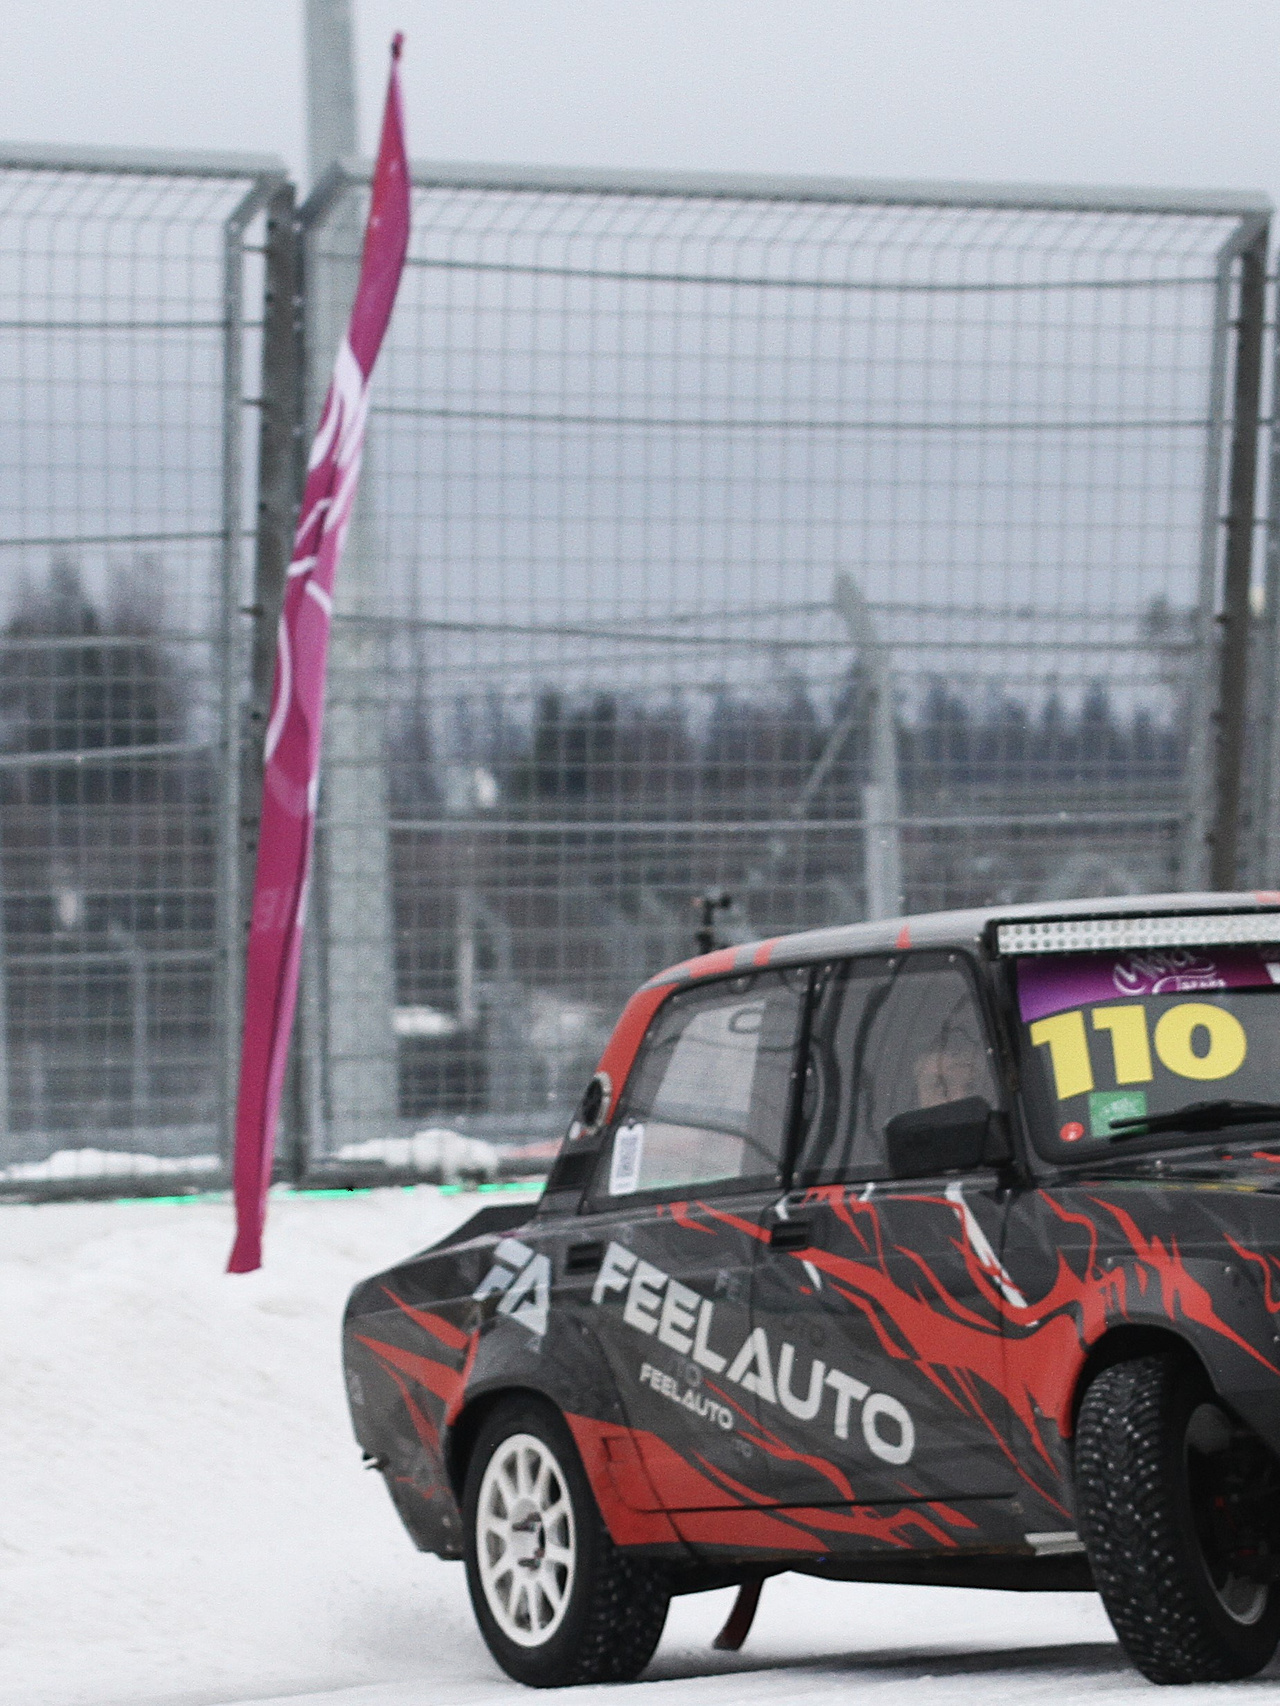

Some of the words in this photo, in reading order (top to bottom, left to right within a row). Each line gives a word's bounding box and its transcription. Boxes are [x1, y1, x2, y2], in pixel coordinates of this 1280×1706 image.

[1030, 1003, 1247, 1100] 110
[591, 1240, 916, 1465] FEELAUTO
[639, 1362, 735, 1431] FEELAUTO
